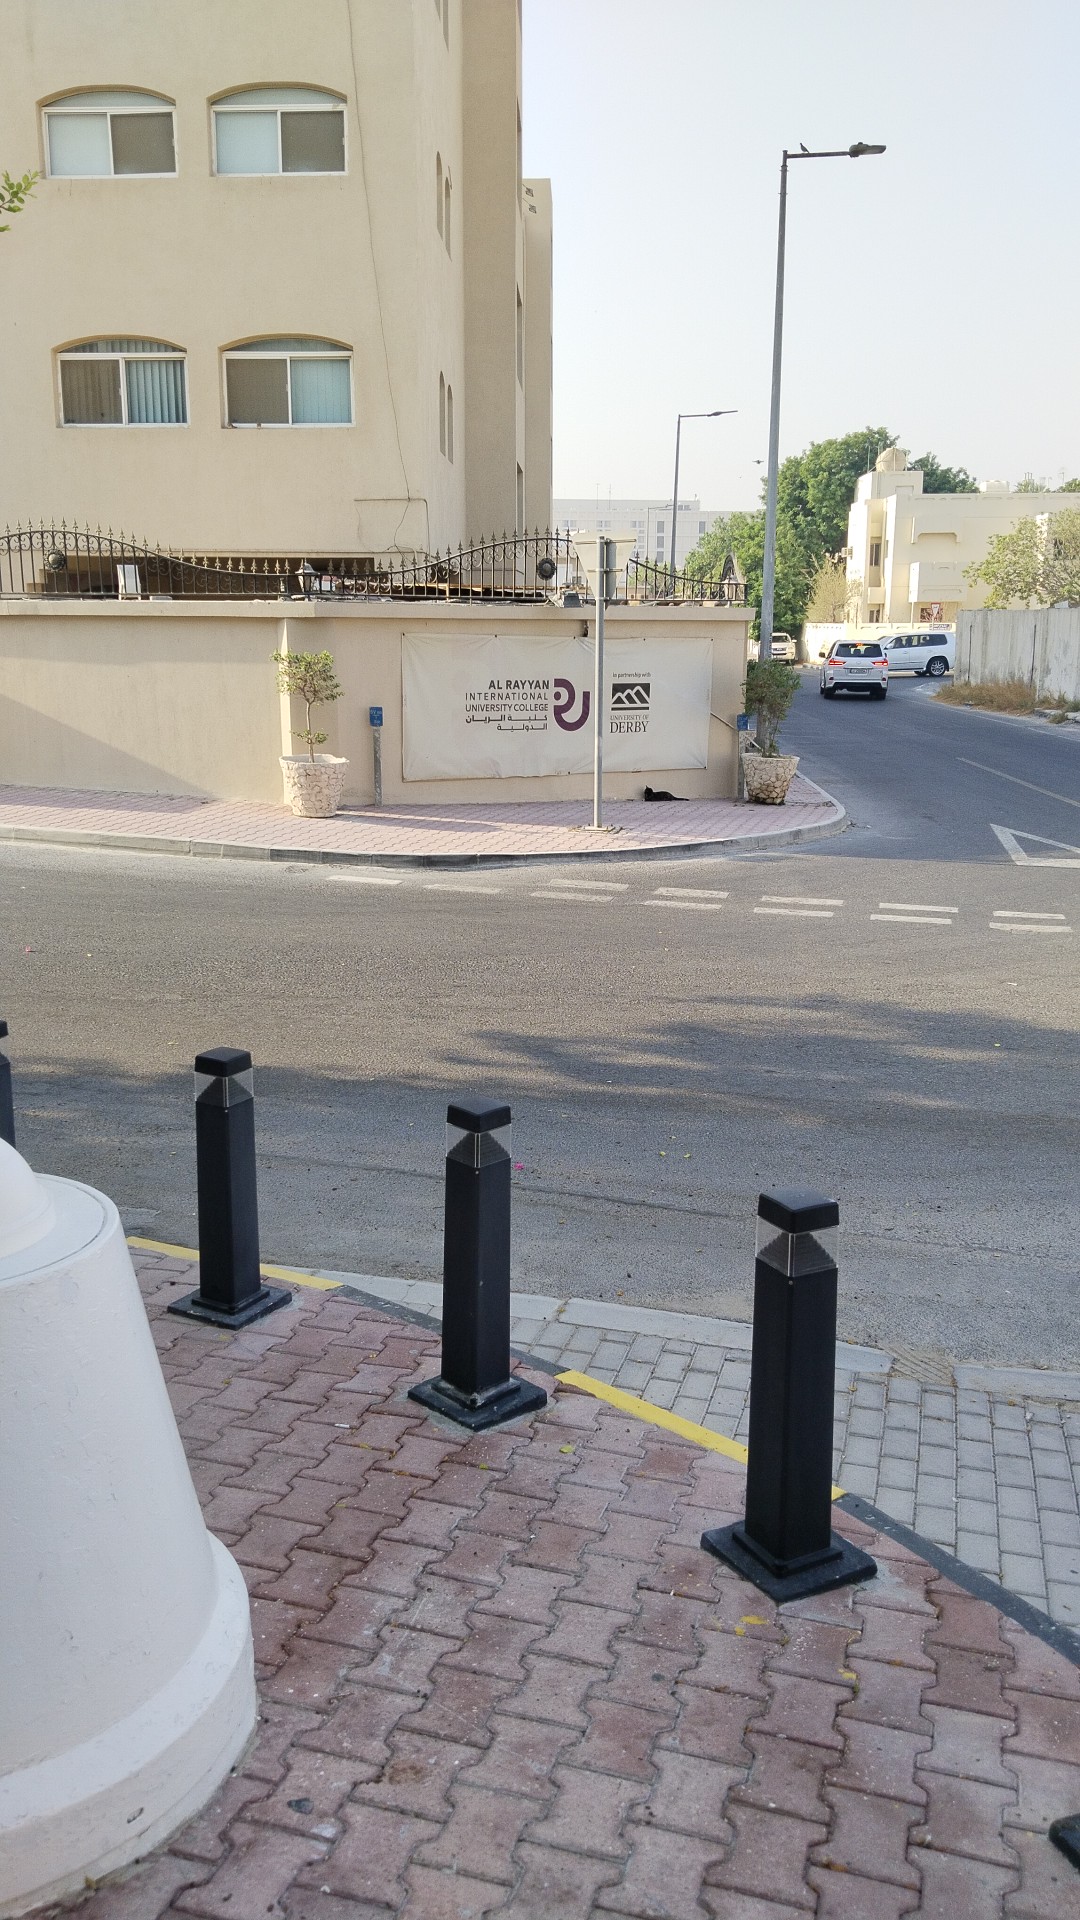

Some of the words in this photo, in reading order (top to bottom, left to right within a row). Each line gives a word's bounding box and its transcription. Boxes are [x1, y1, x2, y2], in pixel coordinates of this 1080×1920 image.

[488, 680, 503, 690] AL
[506, 680, 549, 690] RAYYAN
[465, 692, 549, 701] INTERNATIONAL
[465, 703, 513, 712] UNIVERSITY
[513, 703, 549, 712] COLLEGE
[610, 721, 650, 734] DERBY
